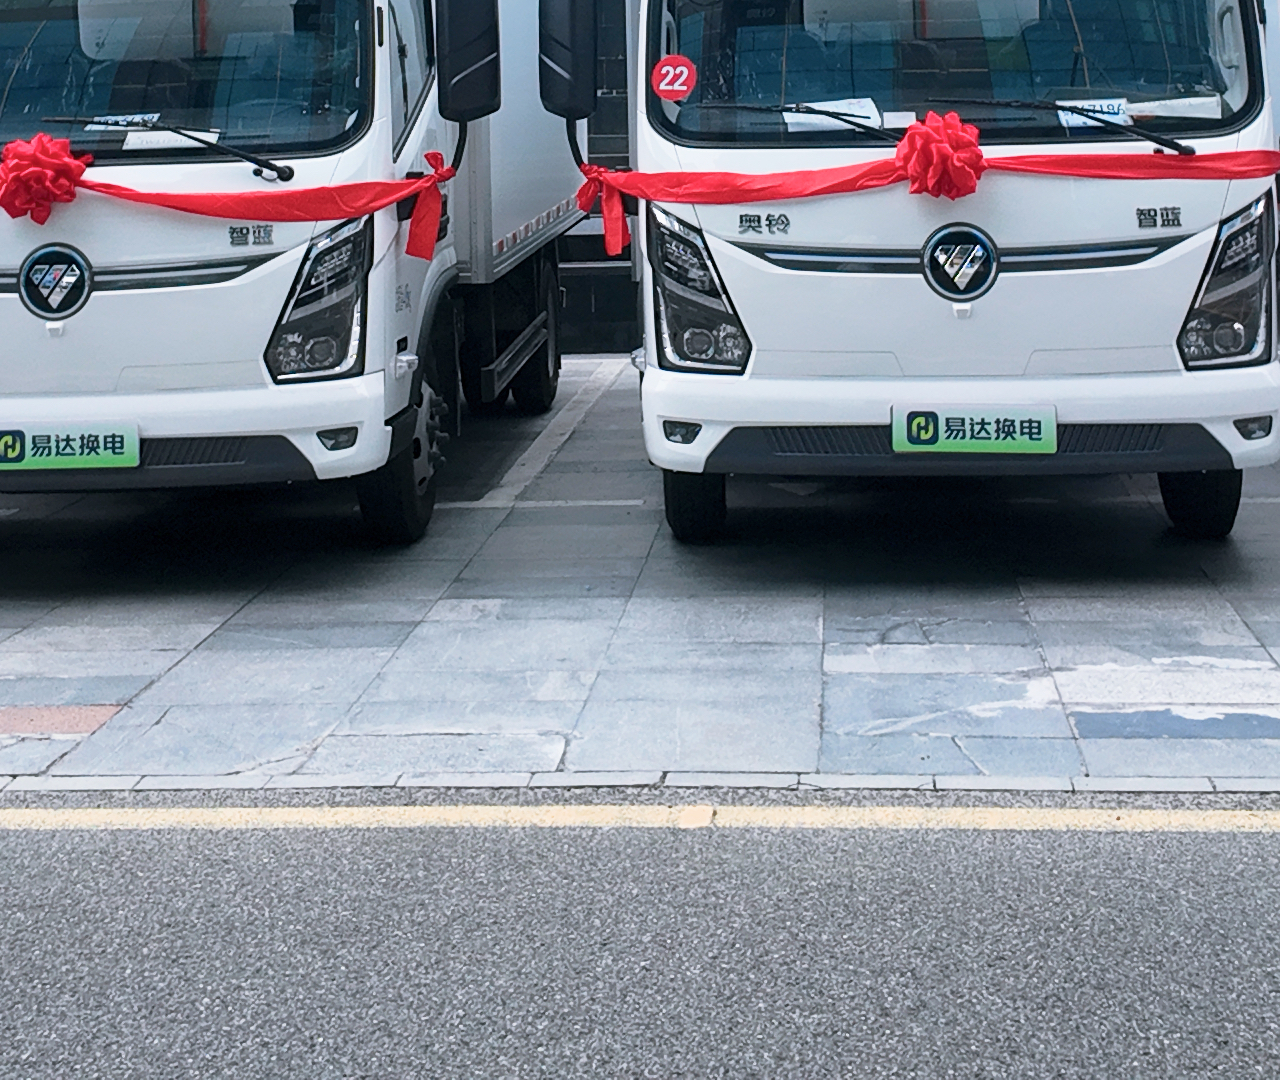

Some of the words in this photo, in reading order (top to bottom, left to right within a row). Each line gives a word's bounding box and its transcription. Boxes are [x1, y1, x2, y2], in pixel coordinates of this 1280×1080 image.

[658, 67, 689, 91] 22
[738, 213, 791, 235] 奥铃
[1135, 206, 1183, 230] 智蓝
[228, 222, 275, 246] 智蓝
[944, 417, 1043, 442] 易达换电
[30, 433, 125, 458] 易达换电
